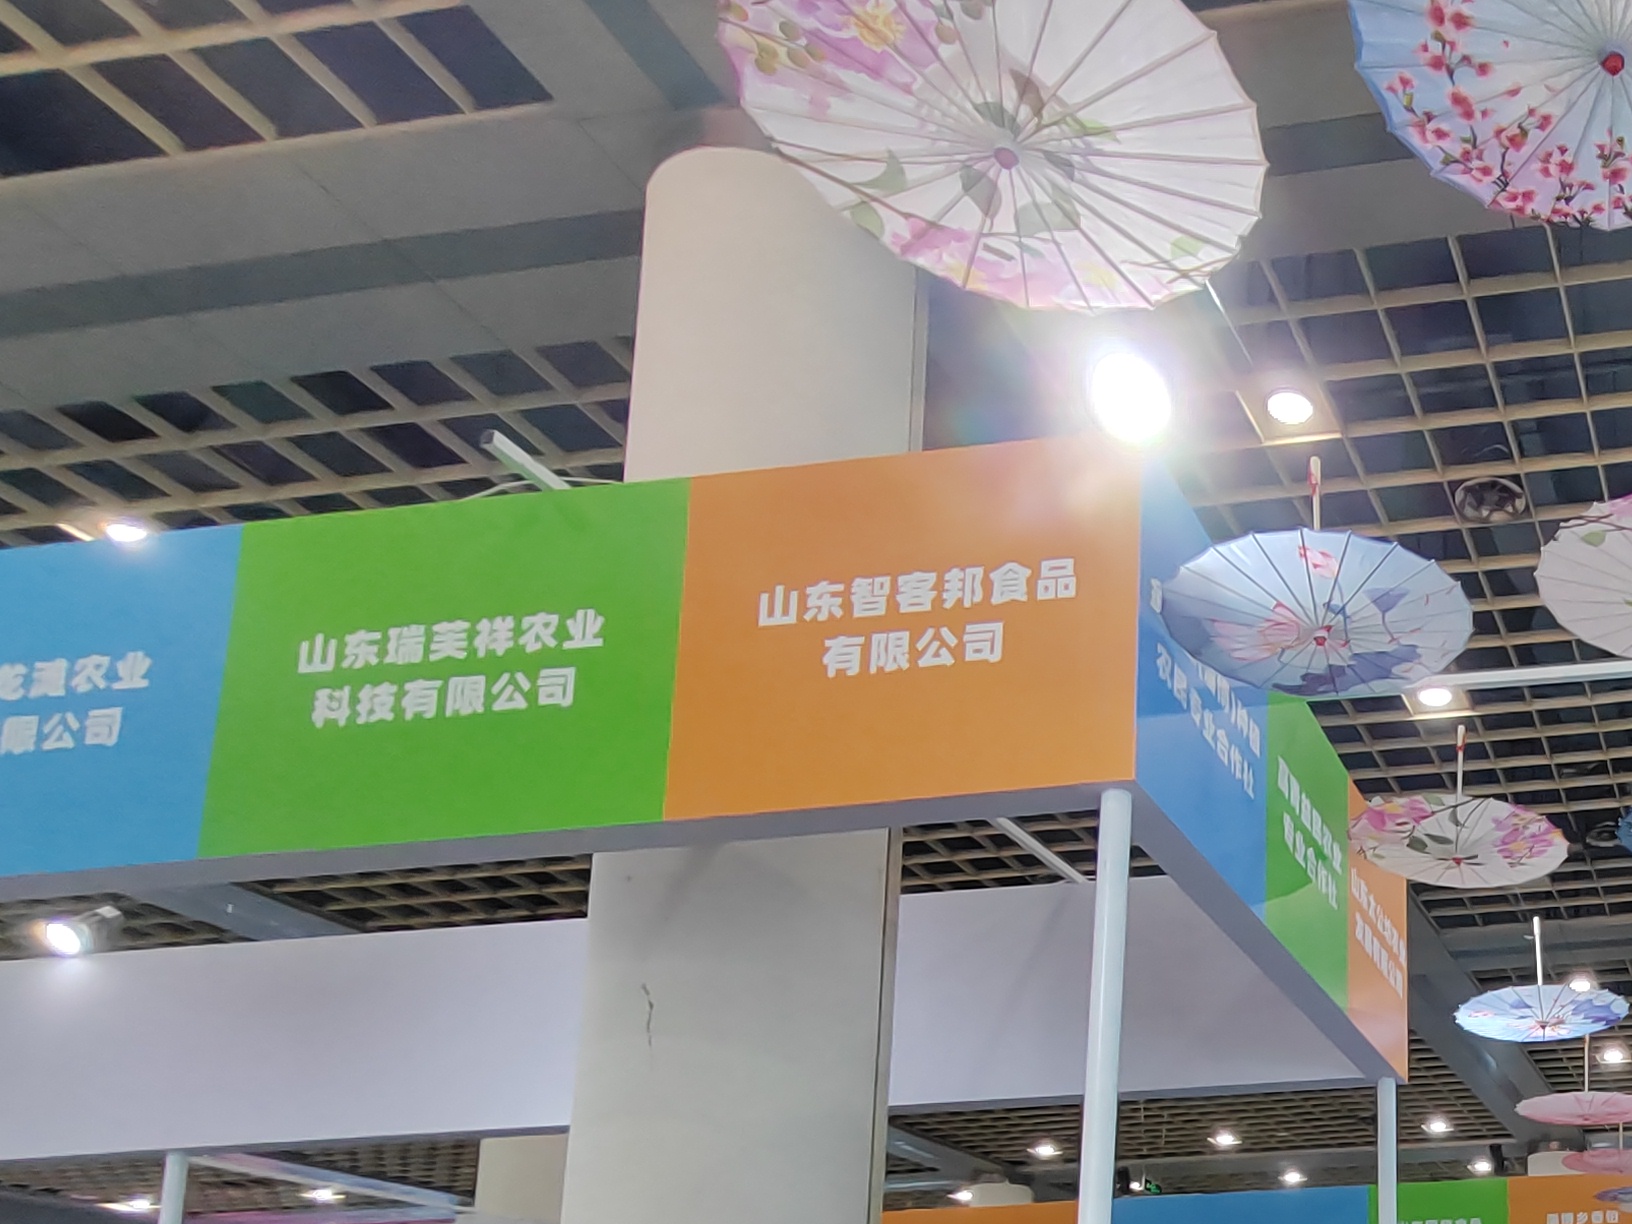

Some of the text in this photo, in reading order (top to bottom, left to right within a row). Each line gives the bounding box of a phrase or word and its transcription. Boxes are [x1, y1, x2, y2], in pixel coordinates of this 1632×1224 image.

[758, 558, 1076, 627] 山东智客邦食品
[298, 609, 604, 673] 山东瑞芙祥农业
[822, 621, 1004, 678] 有限公司
[311, 667, 576, 728] 科技有限公司
[0, 706, 123, 755] 限公司
